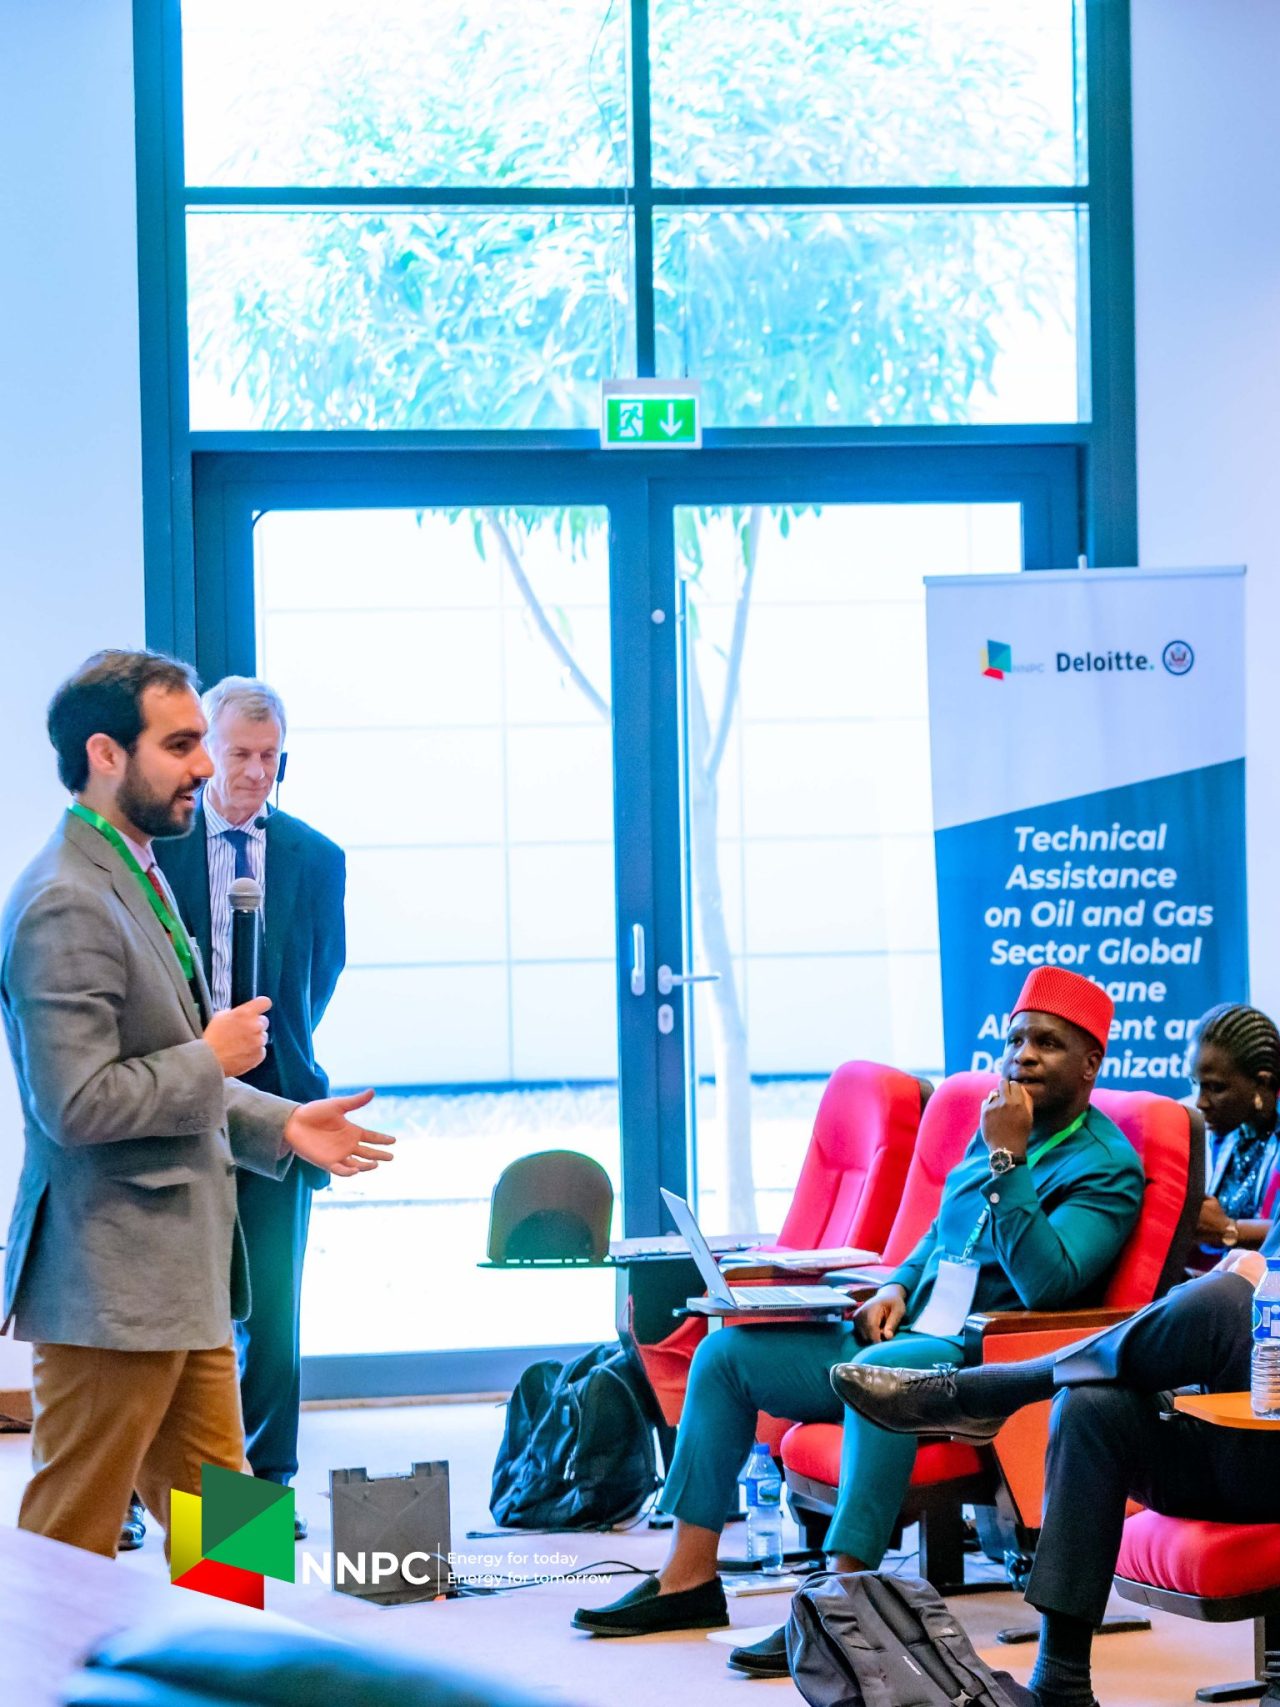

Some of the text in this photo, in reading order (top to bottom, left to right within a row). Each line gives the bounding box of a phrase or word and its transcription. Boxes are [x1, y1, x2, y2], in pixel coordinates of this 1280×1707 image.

[1056, 651, 1155, 673] Deloitte.
[1014, 822, 1168, 852] Technical
[1005, 861, 1178, 890] Assistance
[984, 898, 1214, 928] on Oil and Gas
[990, 936, 1203, 965] Sector Global
